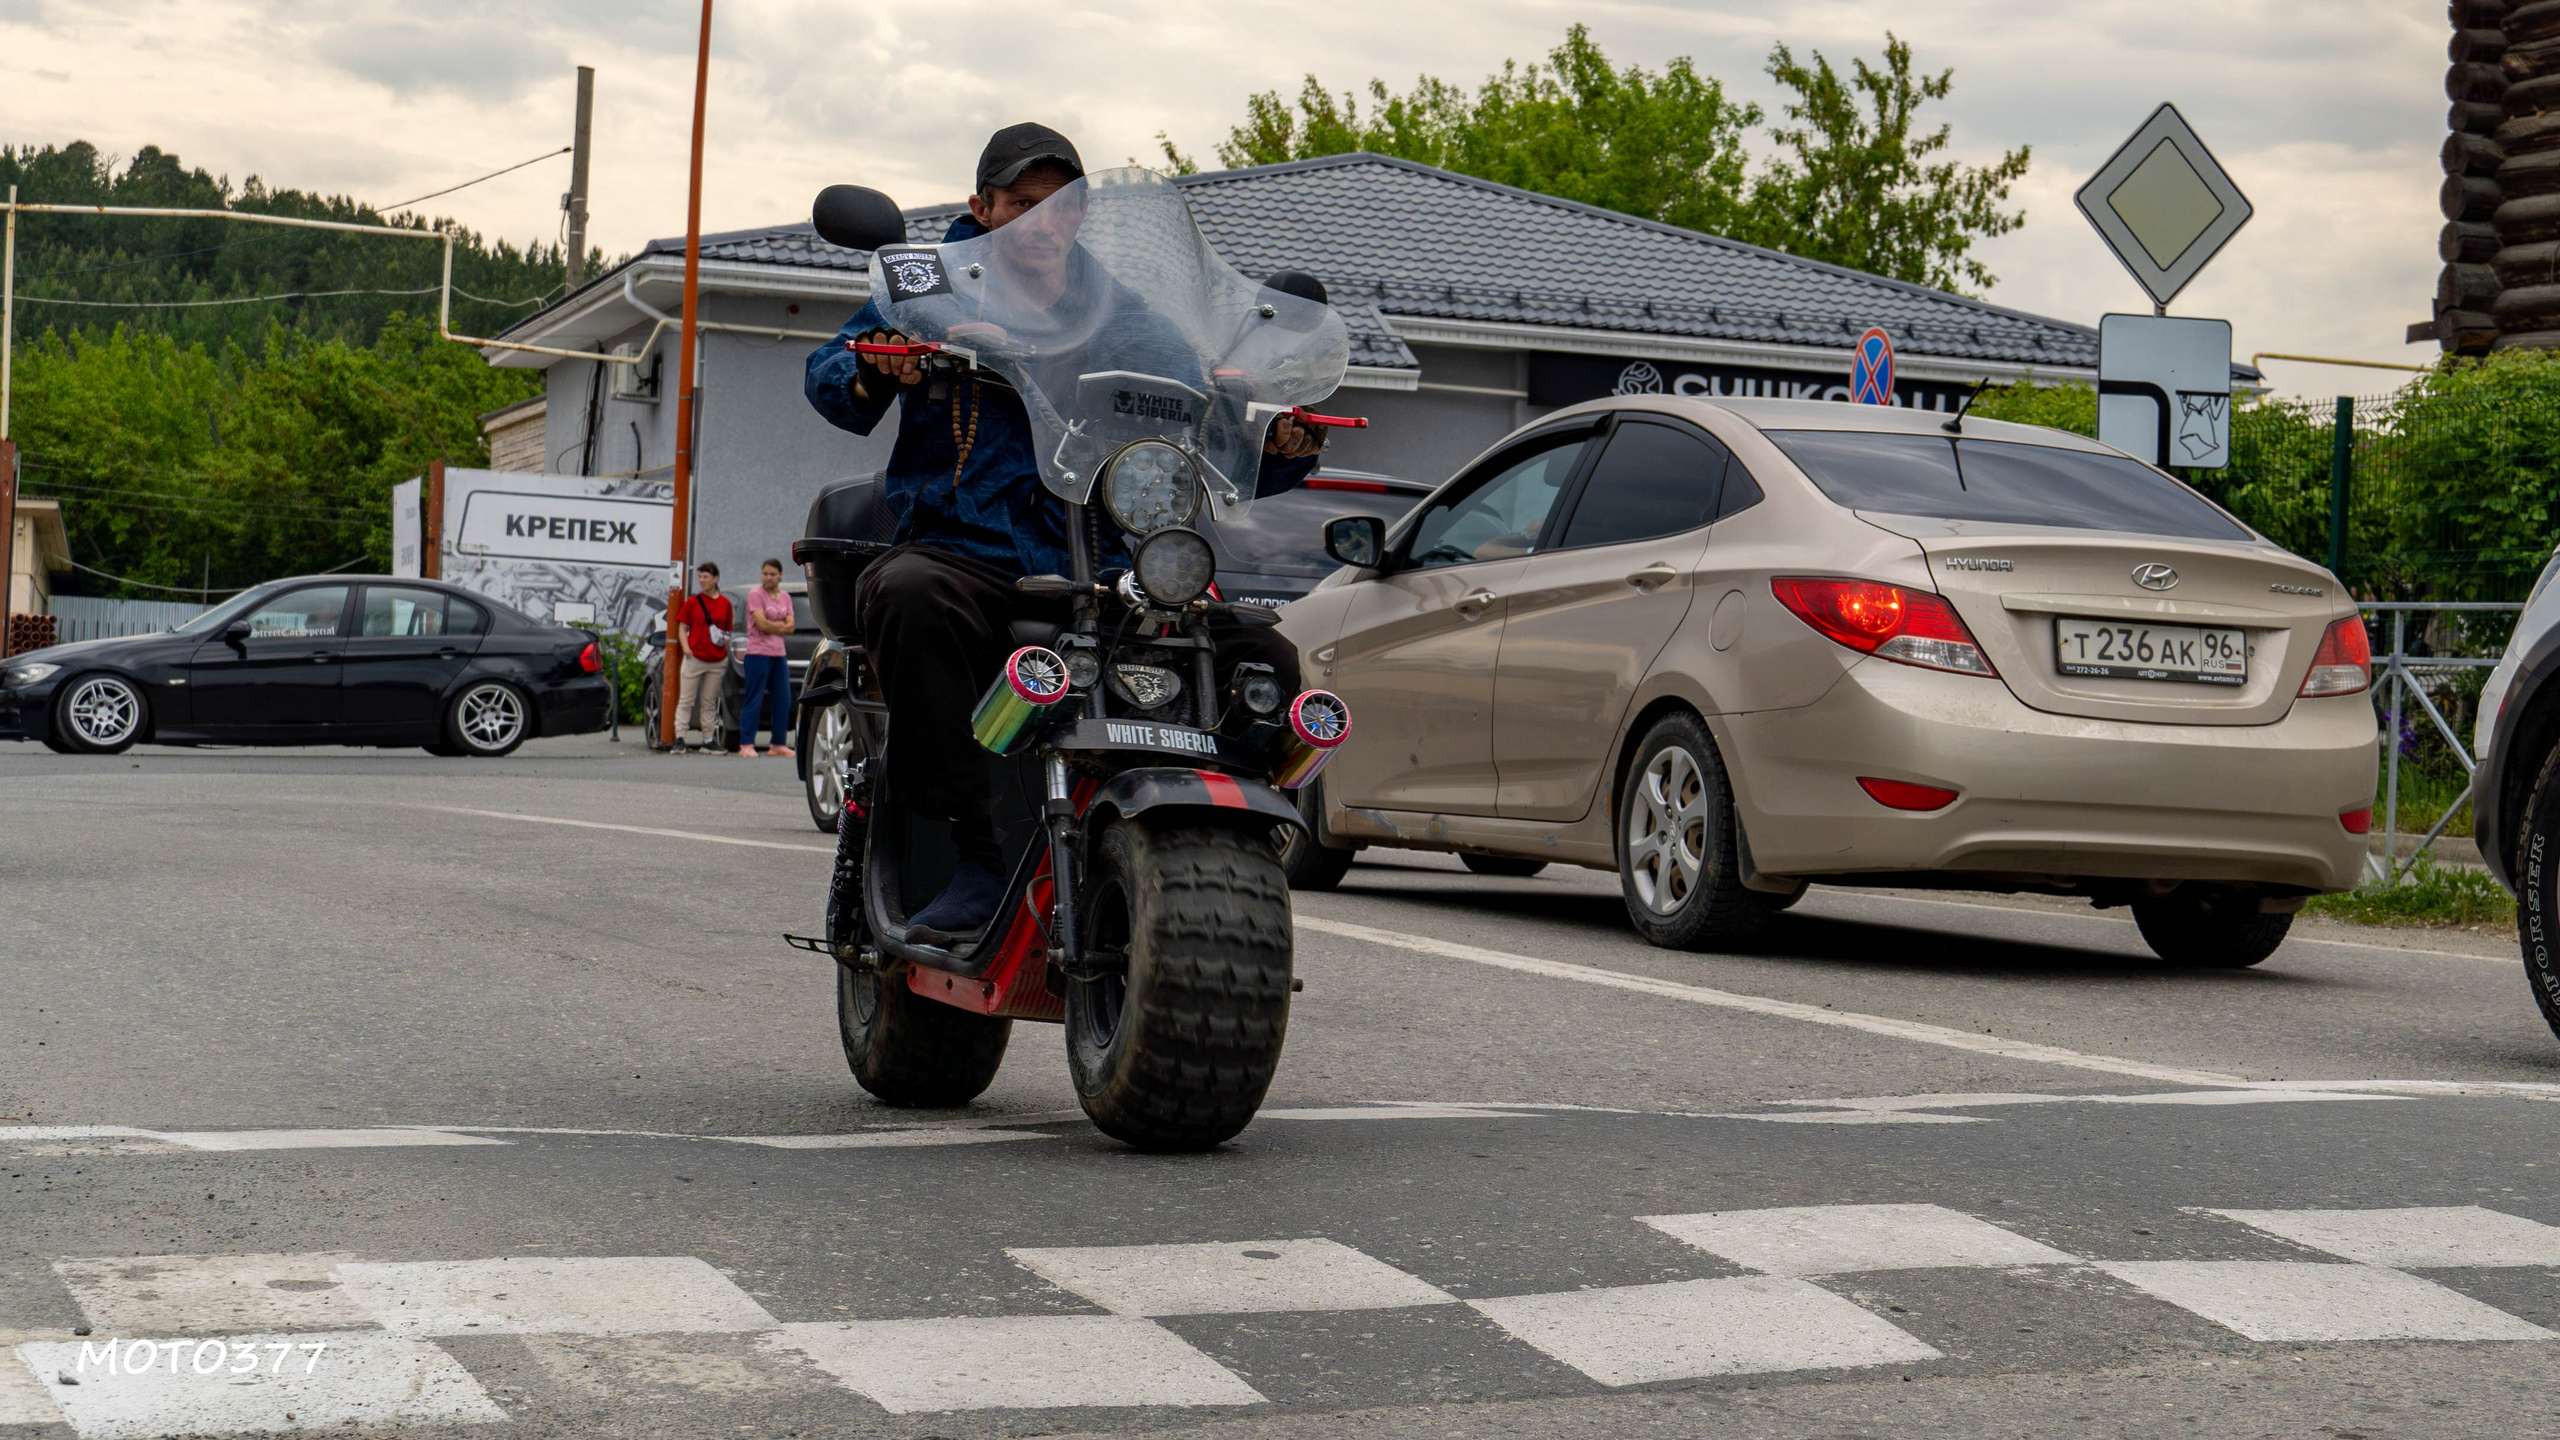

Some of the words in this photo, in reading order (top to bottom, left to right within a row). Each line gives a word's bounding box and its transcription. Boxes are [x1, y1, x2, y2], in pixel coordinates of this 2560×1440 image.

[1137, 392, 1183, 411] WHITE
[1137, 404, 1193, 424] SIBERIA
[506, 514, 638, 545] КРЕПЕЖ
[1946, 557, 2014, 572] HYUNDAI
[2269, 583, 2324, 597] SOLARIS
[2204, 633, 2233, 659] 96
[2076, 666, 2110, 675] 272-26-26
[2203, 658, 2225, 669] RUS
[1106, 723, 1155, 746] WHITE
[1159, 728, 1218, 755] SIBERIA
